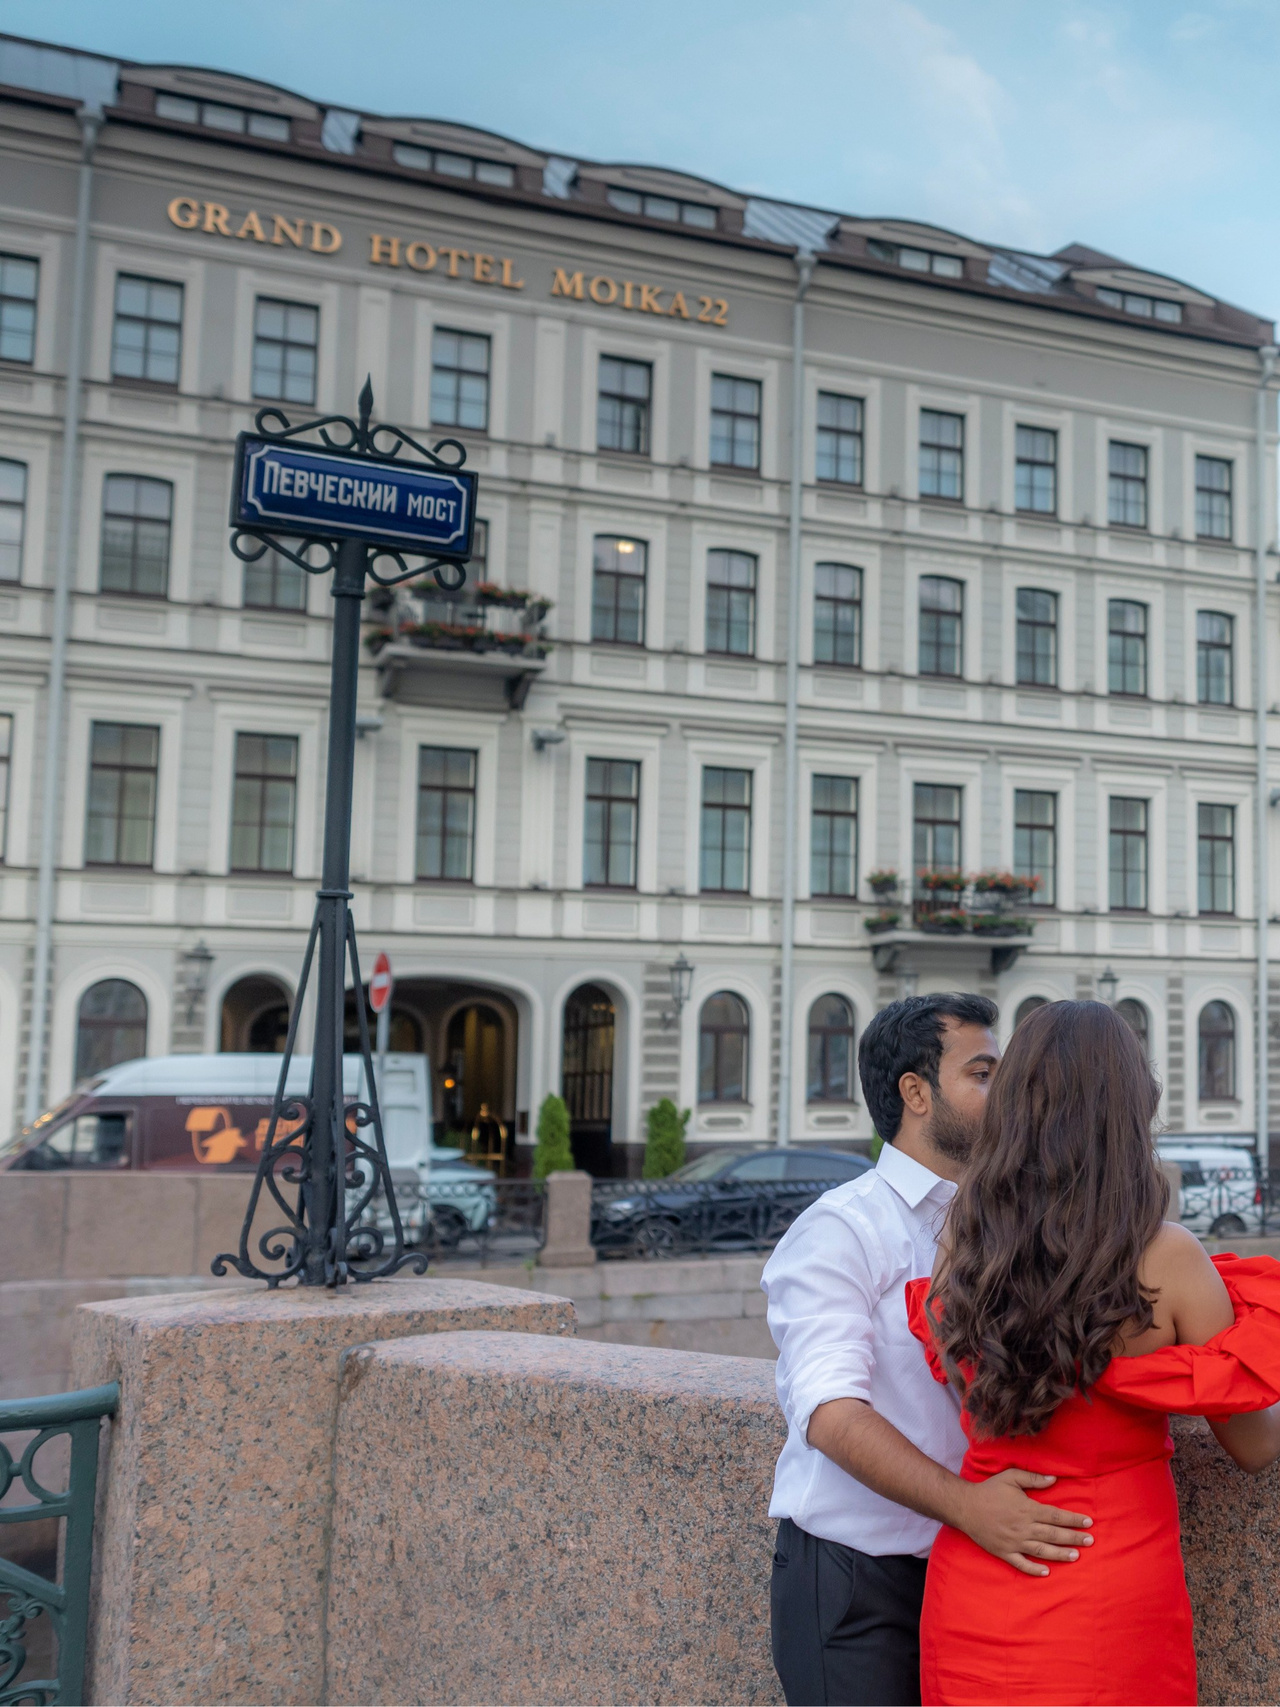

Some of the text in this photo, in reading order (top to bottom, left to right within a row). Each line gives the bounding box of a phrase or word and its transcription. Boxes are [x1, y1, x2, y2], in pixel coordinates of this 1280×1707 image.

[168, 198, 342, 253] GRAND
[370, 234, 524, 289] HOTEL
[262, 460, 457, 523] ПЕВЧЕСКИЙ МОСТ
